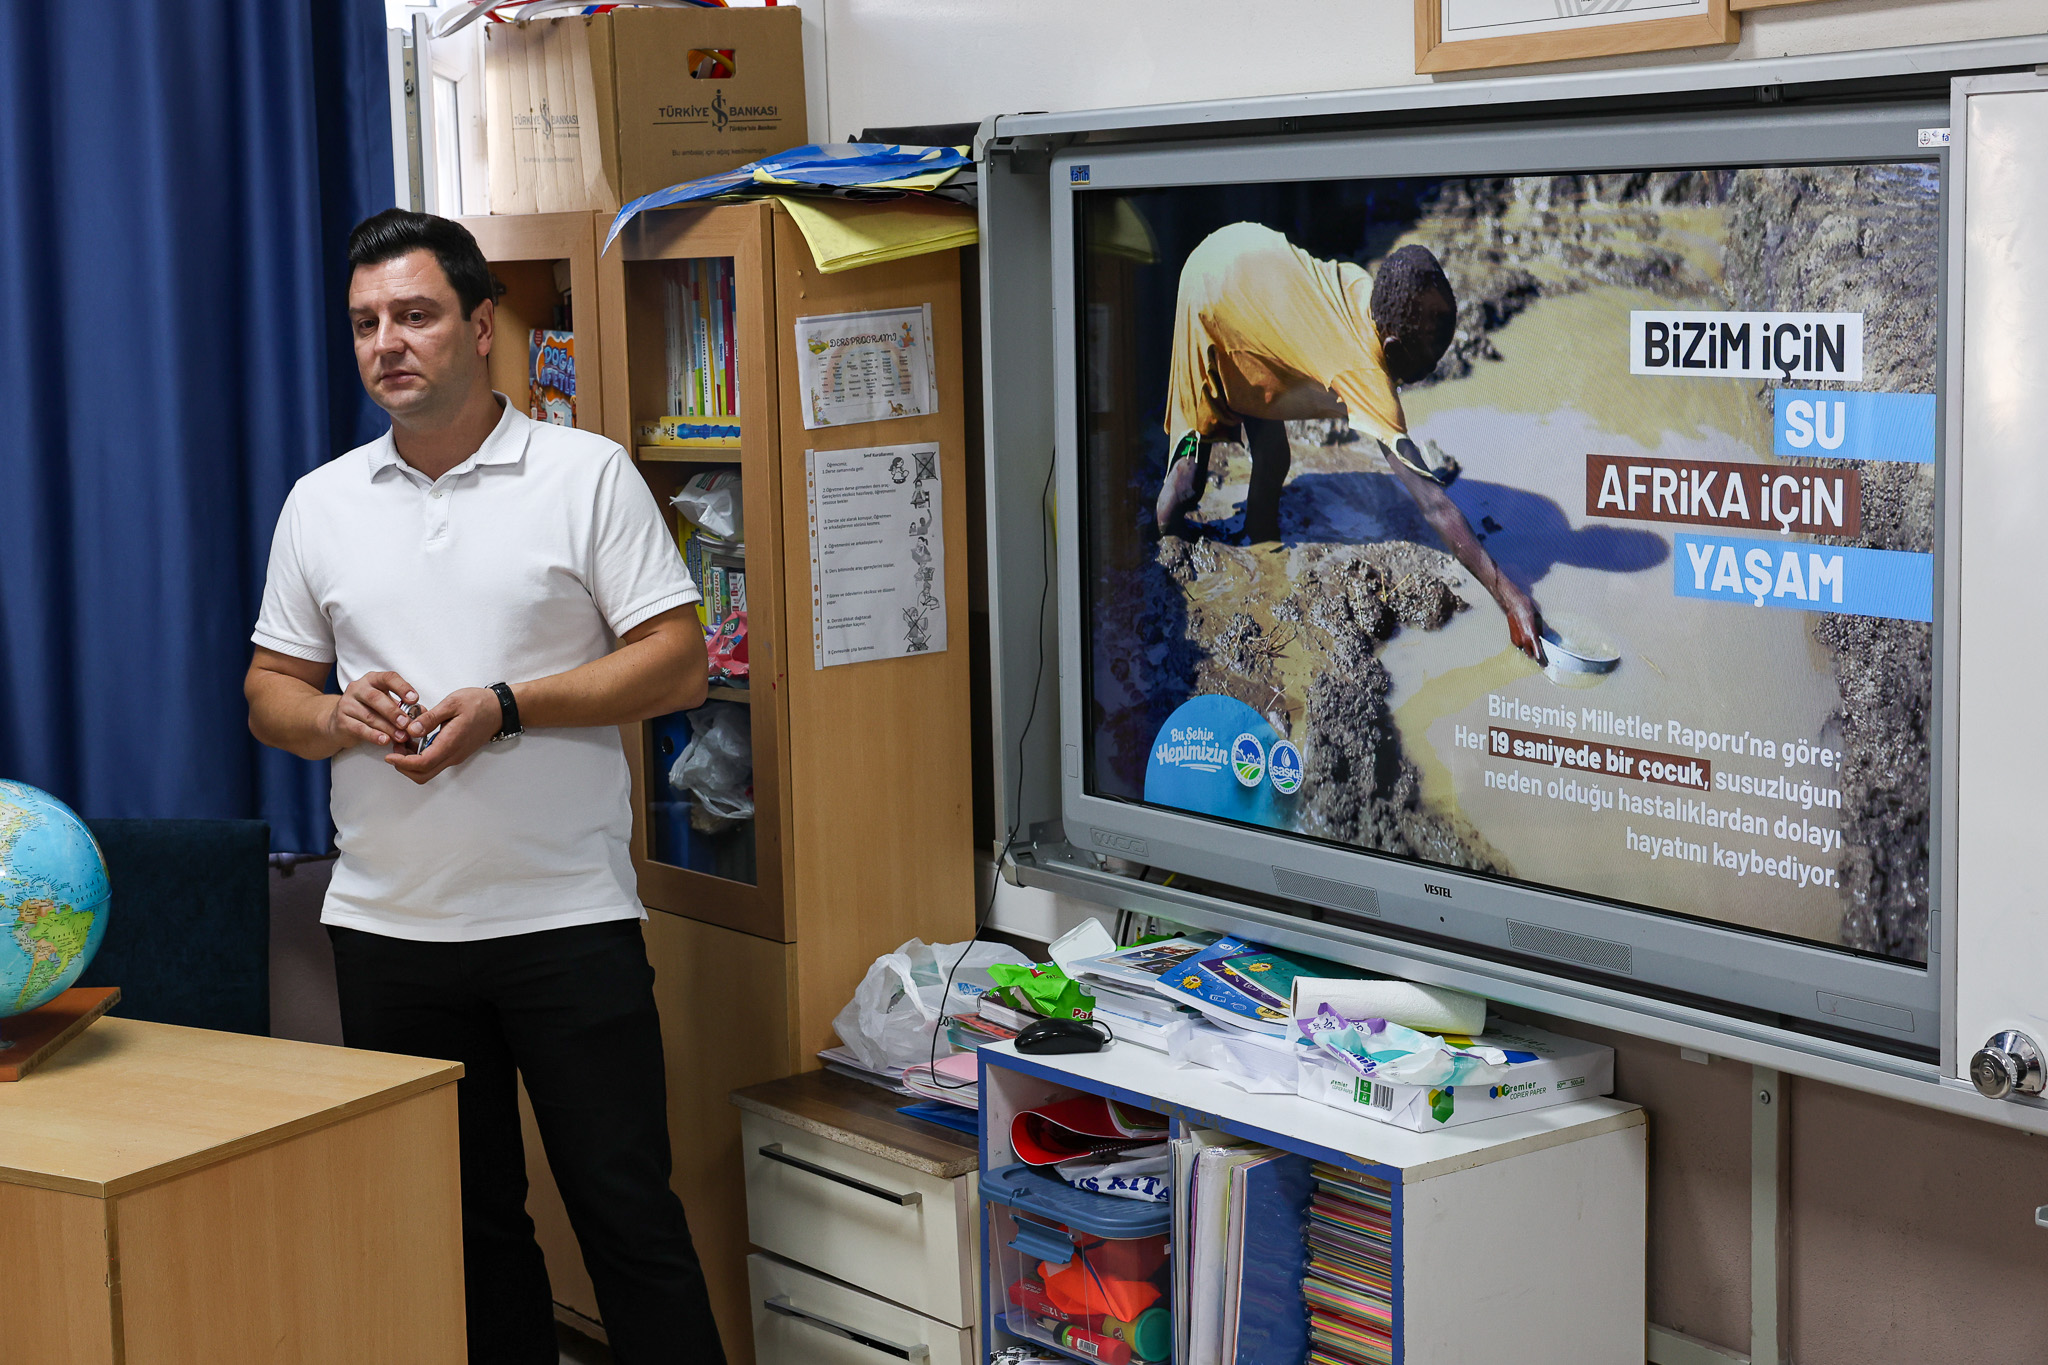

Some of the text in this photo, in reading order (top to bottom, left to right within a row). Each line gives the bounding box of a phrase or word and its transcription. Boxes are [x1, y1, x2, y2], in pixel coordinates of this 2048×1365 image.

[551, 115, 578, 125] BANKASI
[659, 105, 709, 117] TÜRKİYE
[730, 106, 778, 116] BANKASI
[830, 338, 849, 348] DERS
[1644, 321, 1845, 383] BİZİM İÇİN
[1785, 400, 1845, 450] SU
[1597, 464, 1843, 535] AFRİKA İÇİN
[1686, 542, 1843, 607] YAŞAM
[1170, 727, 1214, 744] Bu Şehir
[1488, 693, 1842, 772] Birleşmiş Milletler Raporu'na göre;
[1156, 741, 1229, 767] Hepimizin
[1455, 724, 1842, 811] Her 19 saniyede bir çocuk, susuzluğun
[1485, 768, 1842, 850] neden olduğu hastalıklardan dolayı
[1626, 826, 1840, 889] hayatını kaybediyor.
[1424, 883, 1452, 898] VESTEL
[1072, 1008, 1094, 1019] Paf
[1504, 1081, 1537, 1094] Premier
[1510, 1087, 1547, 1100] COPIER PAPER
